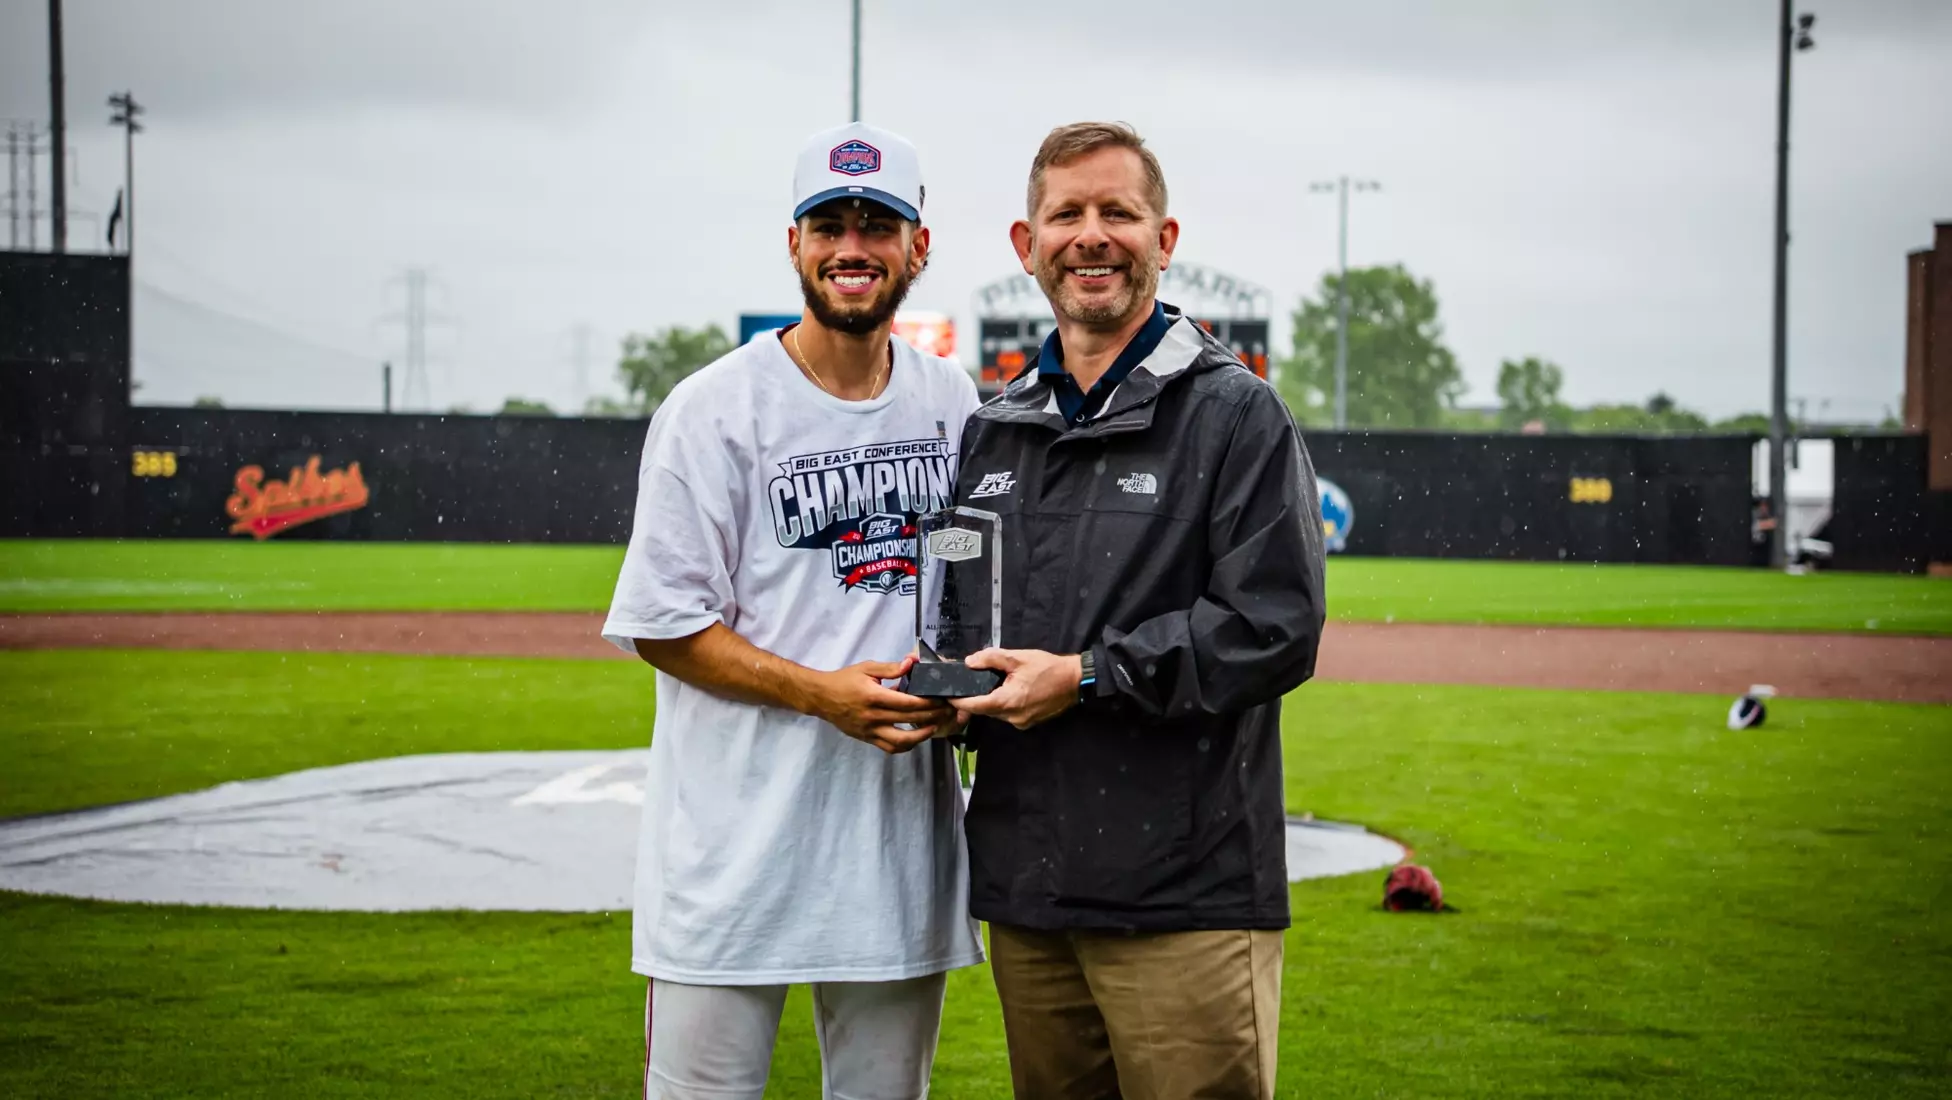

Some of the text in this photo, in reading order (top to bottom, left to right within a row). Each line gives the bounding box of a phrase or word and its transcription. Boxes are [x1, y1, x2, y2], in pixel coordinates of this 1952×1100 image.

[795, 442, 938, 470] BIG EAST CONFERENCE
[983, 471, 1013, 483] BIG
[1116, 478, 1146, 487] NORTH
[1130, 472, 1146, 481] THE
[973, 479, 1017, 494] EAST
[1122, 485, 1144, 493] FACE
[769, 453, 957, 547] CHAMPION
[869, 519, 892, 530] BIG
[866, 525, 899, 537] EAST
[942, 534, 969, 543] BIG
[937, 542, 975, 551] EAST
[838, 538, 917, 568] CHAMPIONSHI
[866, 560, 902, 573] BASEBALL
